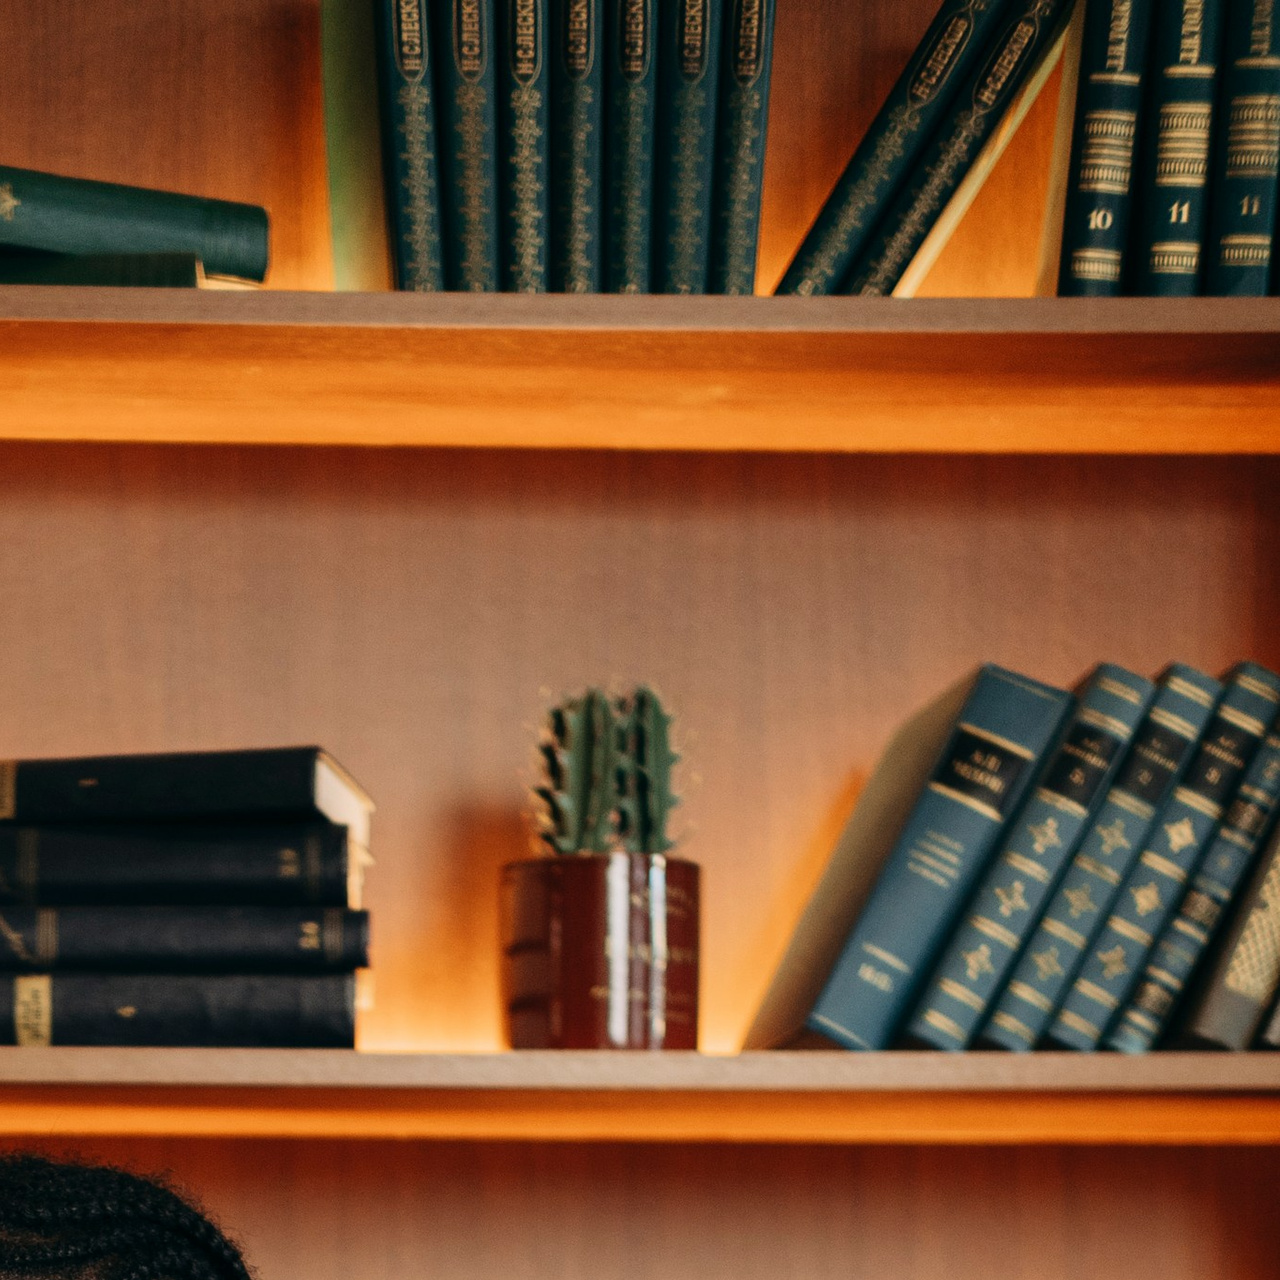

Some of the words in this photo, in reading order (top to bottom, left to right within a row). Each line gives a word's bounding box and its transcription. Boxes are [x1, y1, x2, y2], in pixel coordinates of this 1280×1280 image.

[1168, 198, 1192, 225] 11
[1238, 193, 1262, 217] 11
[1087, 207, 1113, 232] 10
